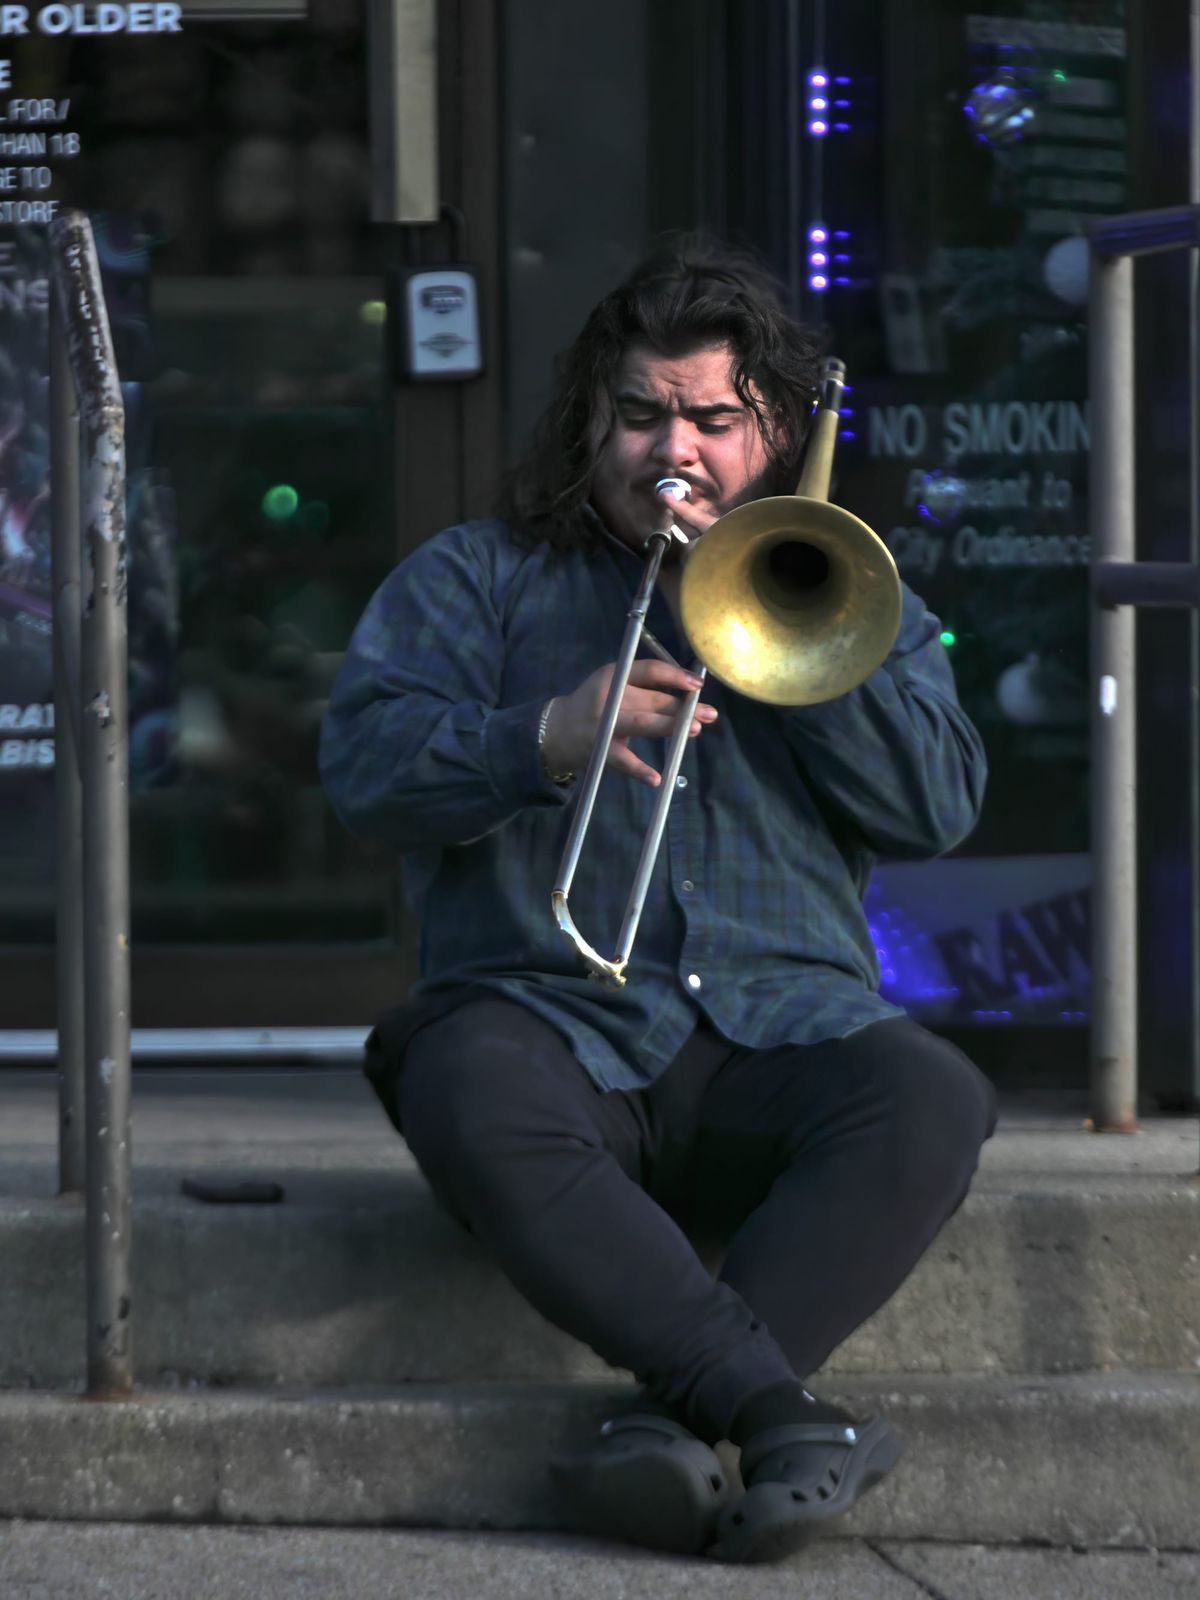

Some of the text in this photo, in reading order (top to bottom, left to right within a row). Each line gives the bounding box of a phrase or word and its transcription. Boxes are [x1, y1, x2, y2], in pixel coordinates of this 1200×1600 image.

[0, 3, 183, 34] R OLDER
[0, 132, 80, 155] HAN 18
[20, 166, 52, 189] TO
[868, 404, 926, 456] NO
[1041, 471, 1073, 508] to
